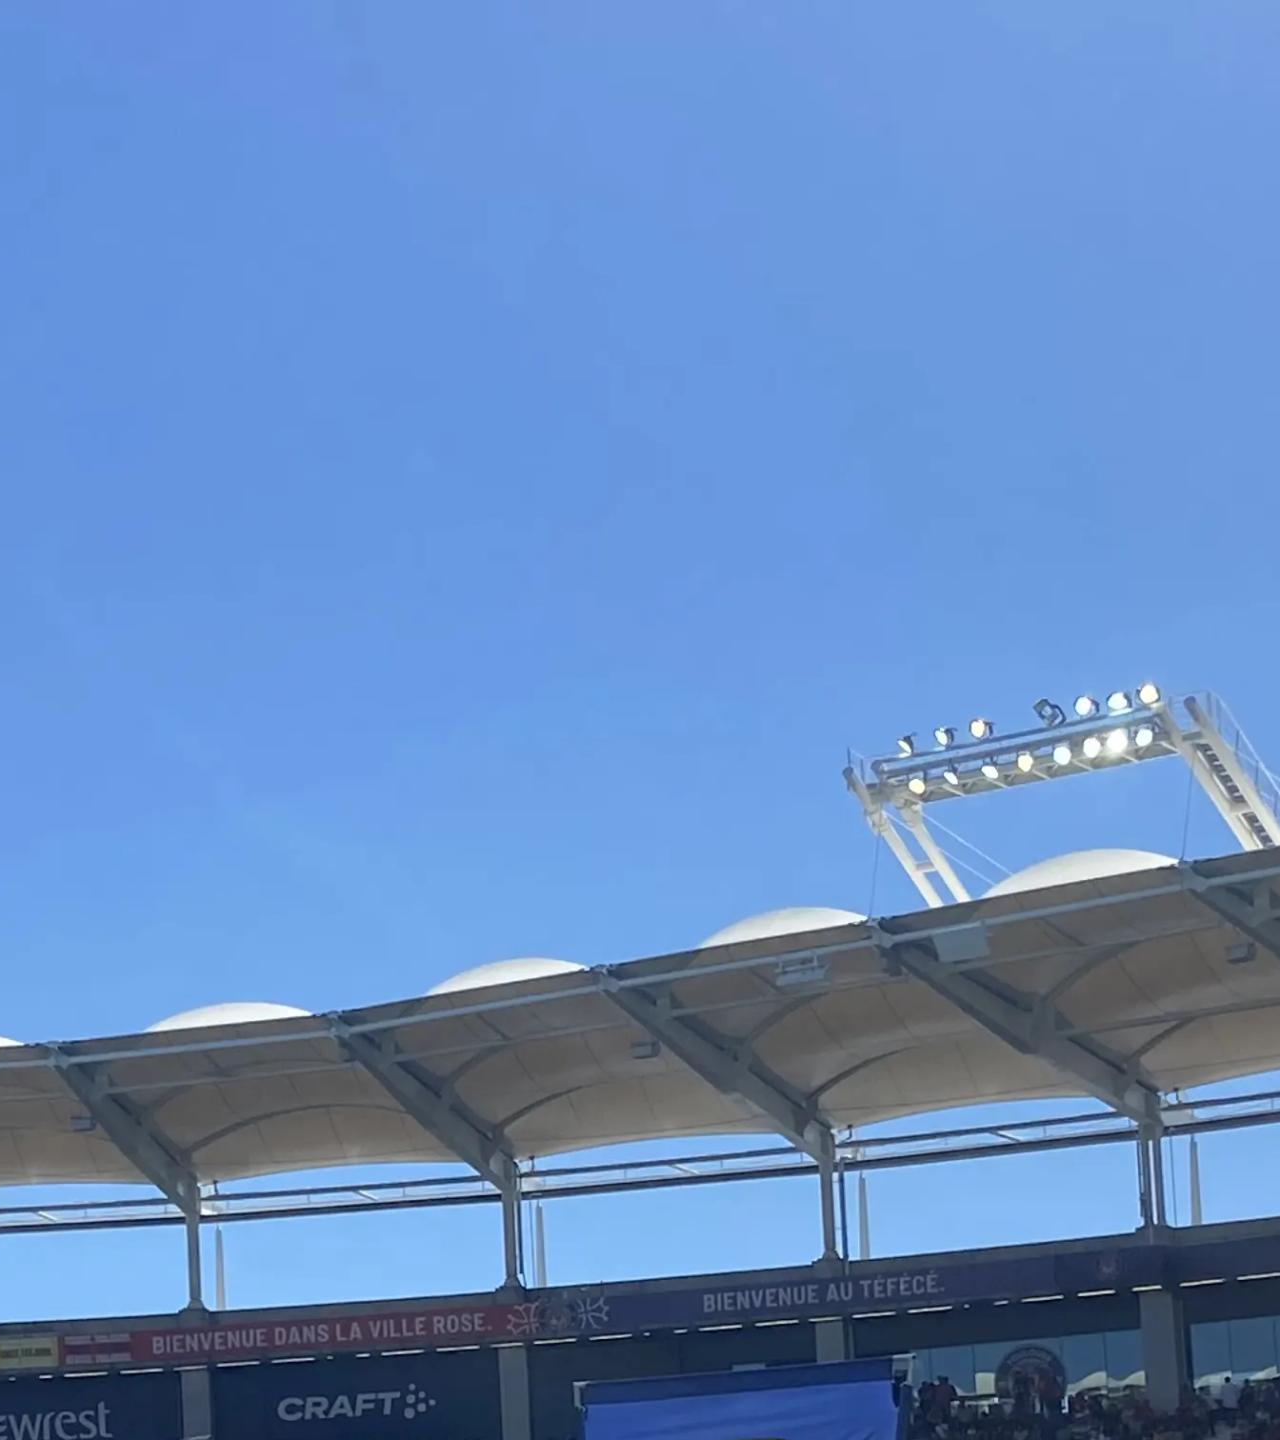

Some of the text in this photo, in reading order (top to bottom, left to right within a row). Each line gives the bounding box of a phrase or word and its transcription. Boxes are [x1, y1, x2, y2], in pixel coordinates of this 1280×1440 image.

[703, 1285, 820, 1313] BIENVENUE
[826, 1282, 853, 1302] AU
[152, 1327, 268, 1355] BIENVENUE
[274, 1324, 330, 1347] DANS
[336, 1321, 363, 1342] LA
[368, 1316, 426, 1340] VILLE
[433, 1312, 493, 1334] ROSE.
[277, 1391, 401, 1421] CRAFT
